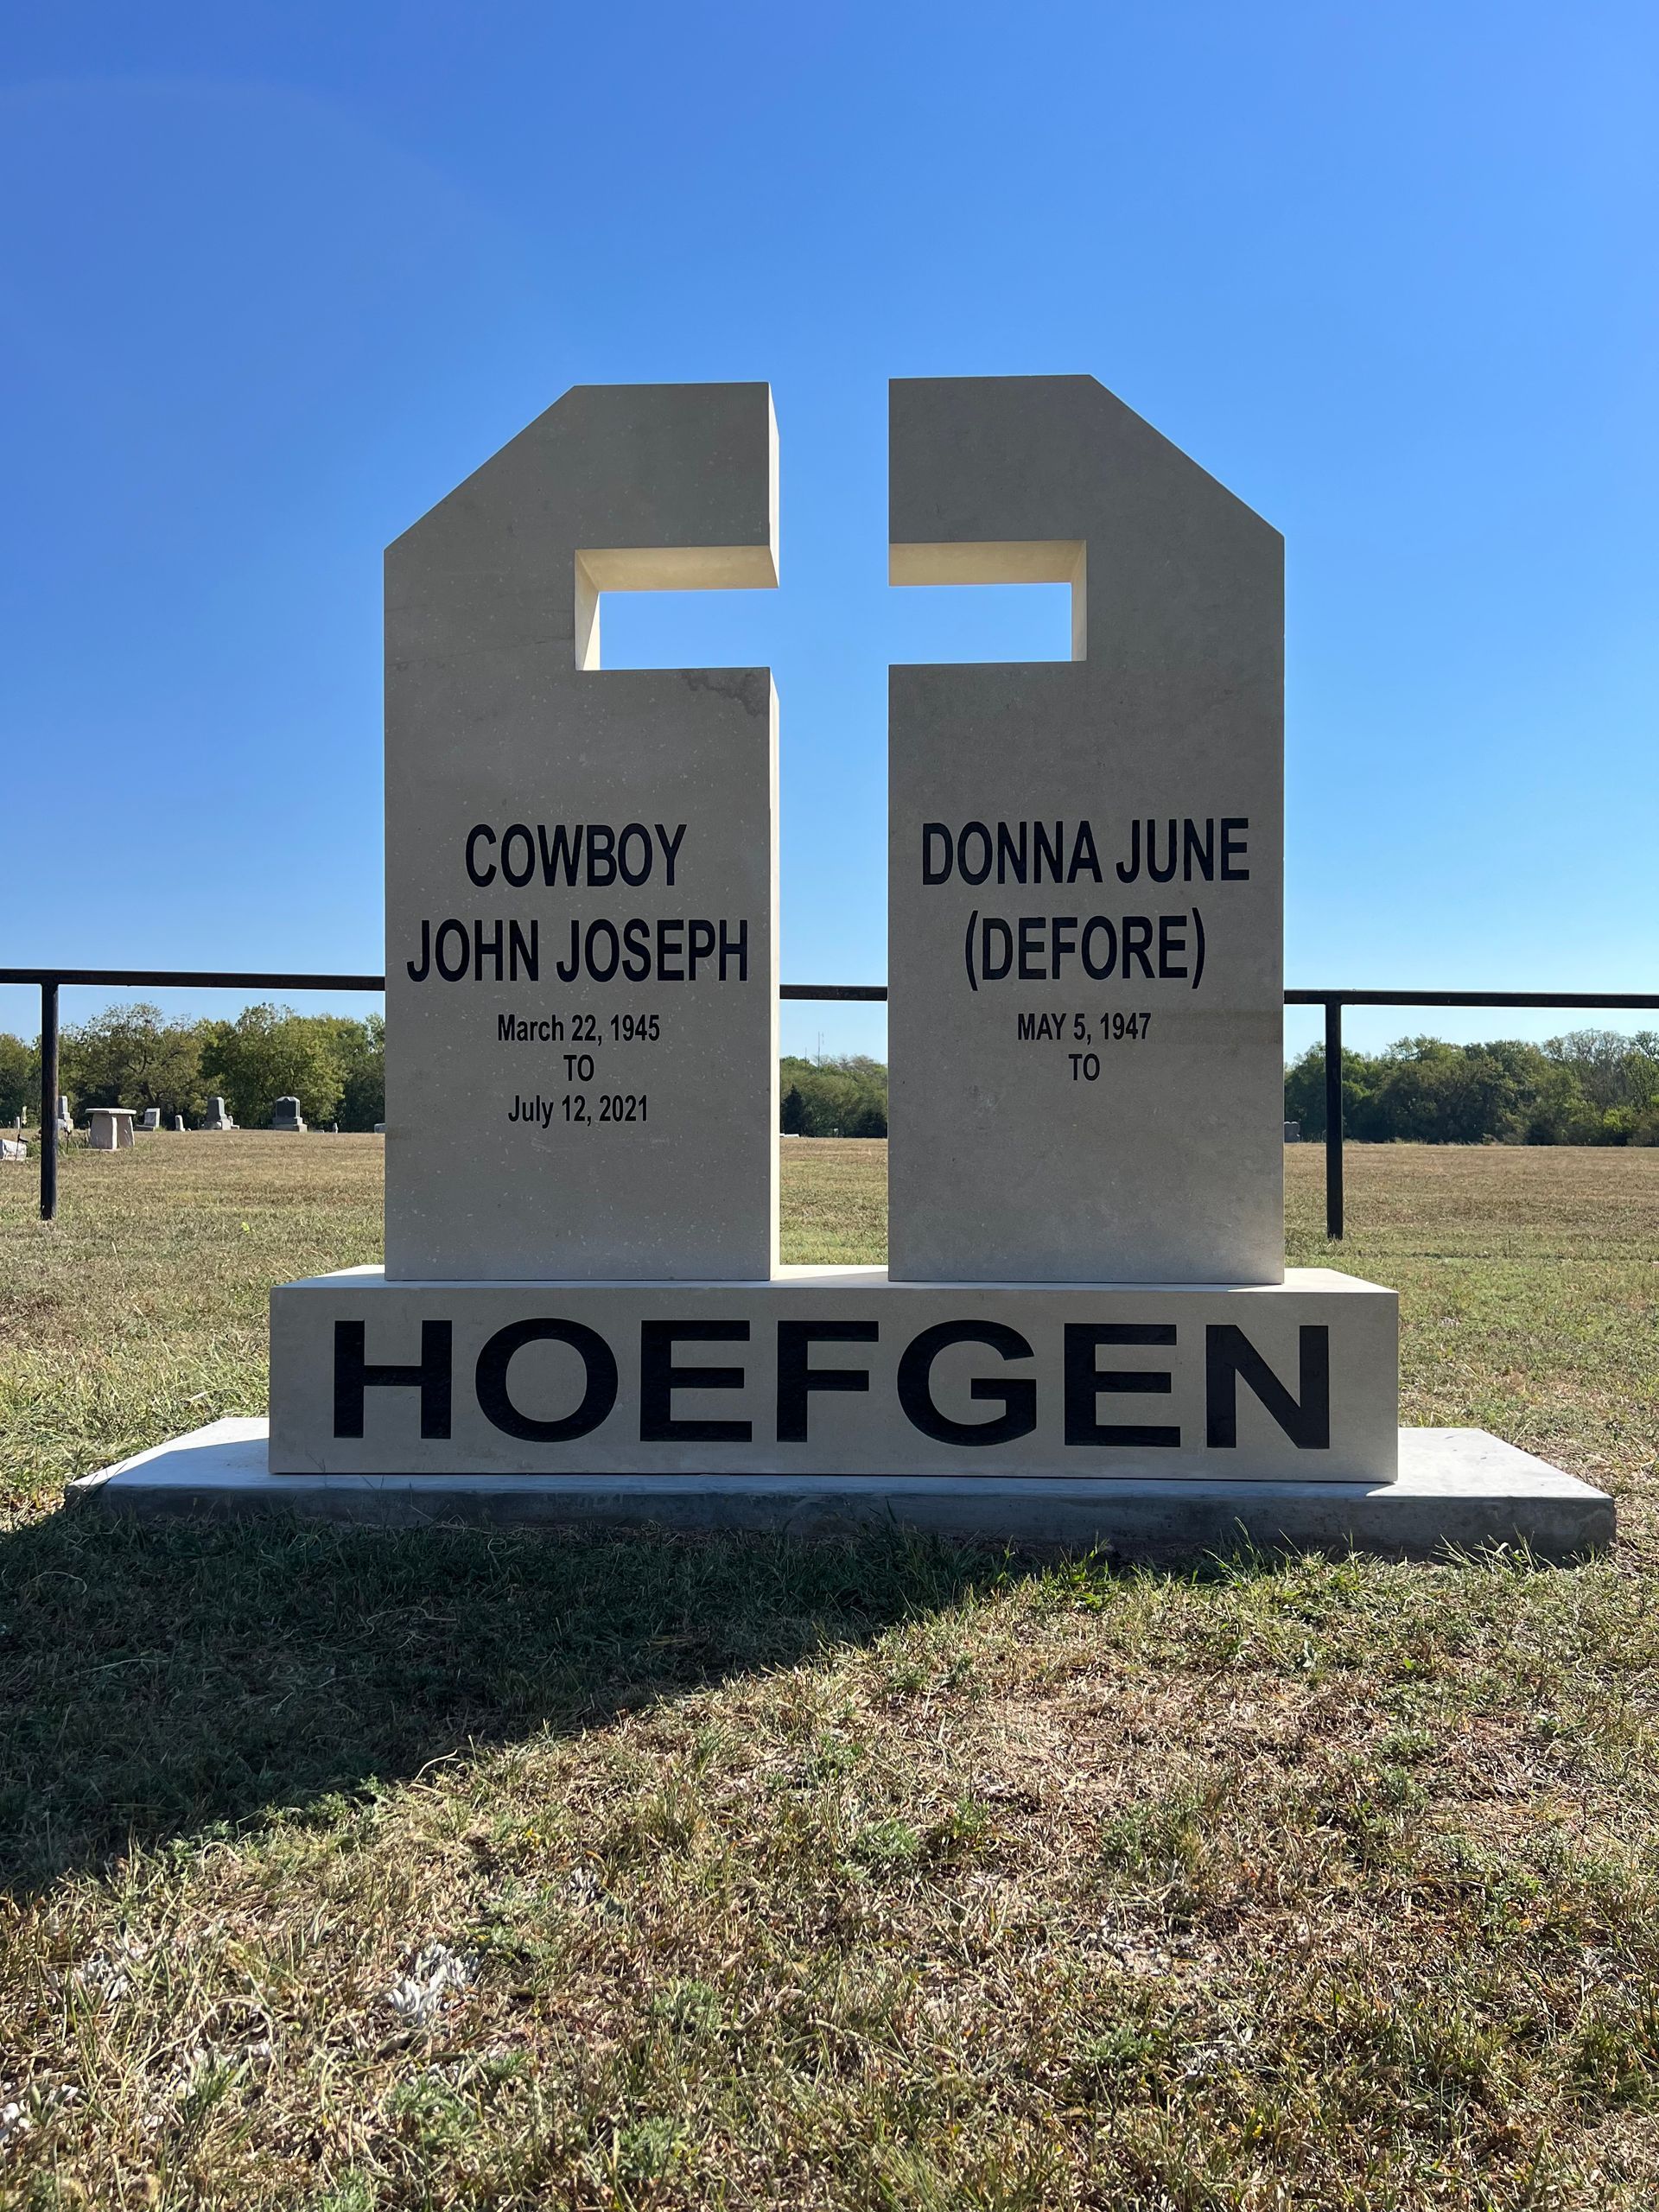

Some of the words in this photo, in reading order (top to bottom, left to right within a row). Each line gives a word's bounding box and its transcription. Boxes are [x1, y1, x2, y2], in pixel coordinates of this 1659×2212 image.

[465, 823, 688, 888] COWBOY
[922, 820, 1103, 887] DONNA
[1116, 817, 1251, 885] JUNE
[406, 918, 539, 983] JOHN
[556, 918, 748, 983] JOSEPH
[964, 906, 1205, 992] (DEFORE)
[498, 1014, 564, 1042] March
[571, 1014, 602, 1047] 22,
[610, 1014, 660, 1042] 1945
[1017, 1012, 1067, 1041] MAY
[1073, 1013, 1092, 1046] 5,
[1099, 1012, 1152, 1040] 1947
[563, 1053, 594, 1083] TO
[1067, 1052, 1101, 1082] TO
[507, 1094, 555, 1129] July
[562, 1094, 592, 1128] 12,
[598, 1094, 647, 1122] 2021
[333, 1317, 1332, 1451] HOEFGEN
